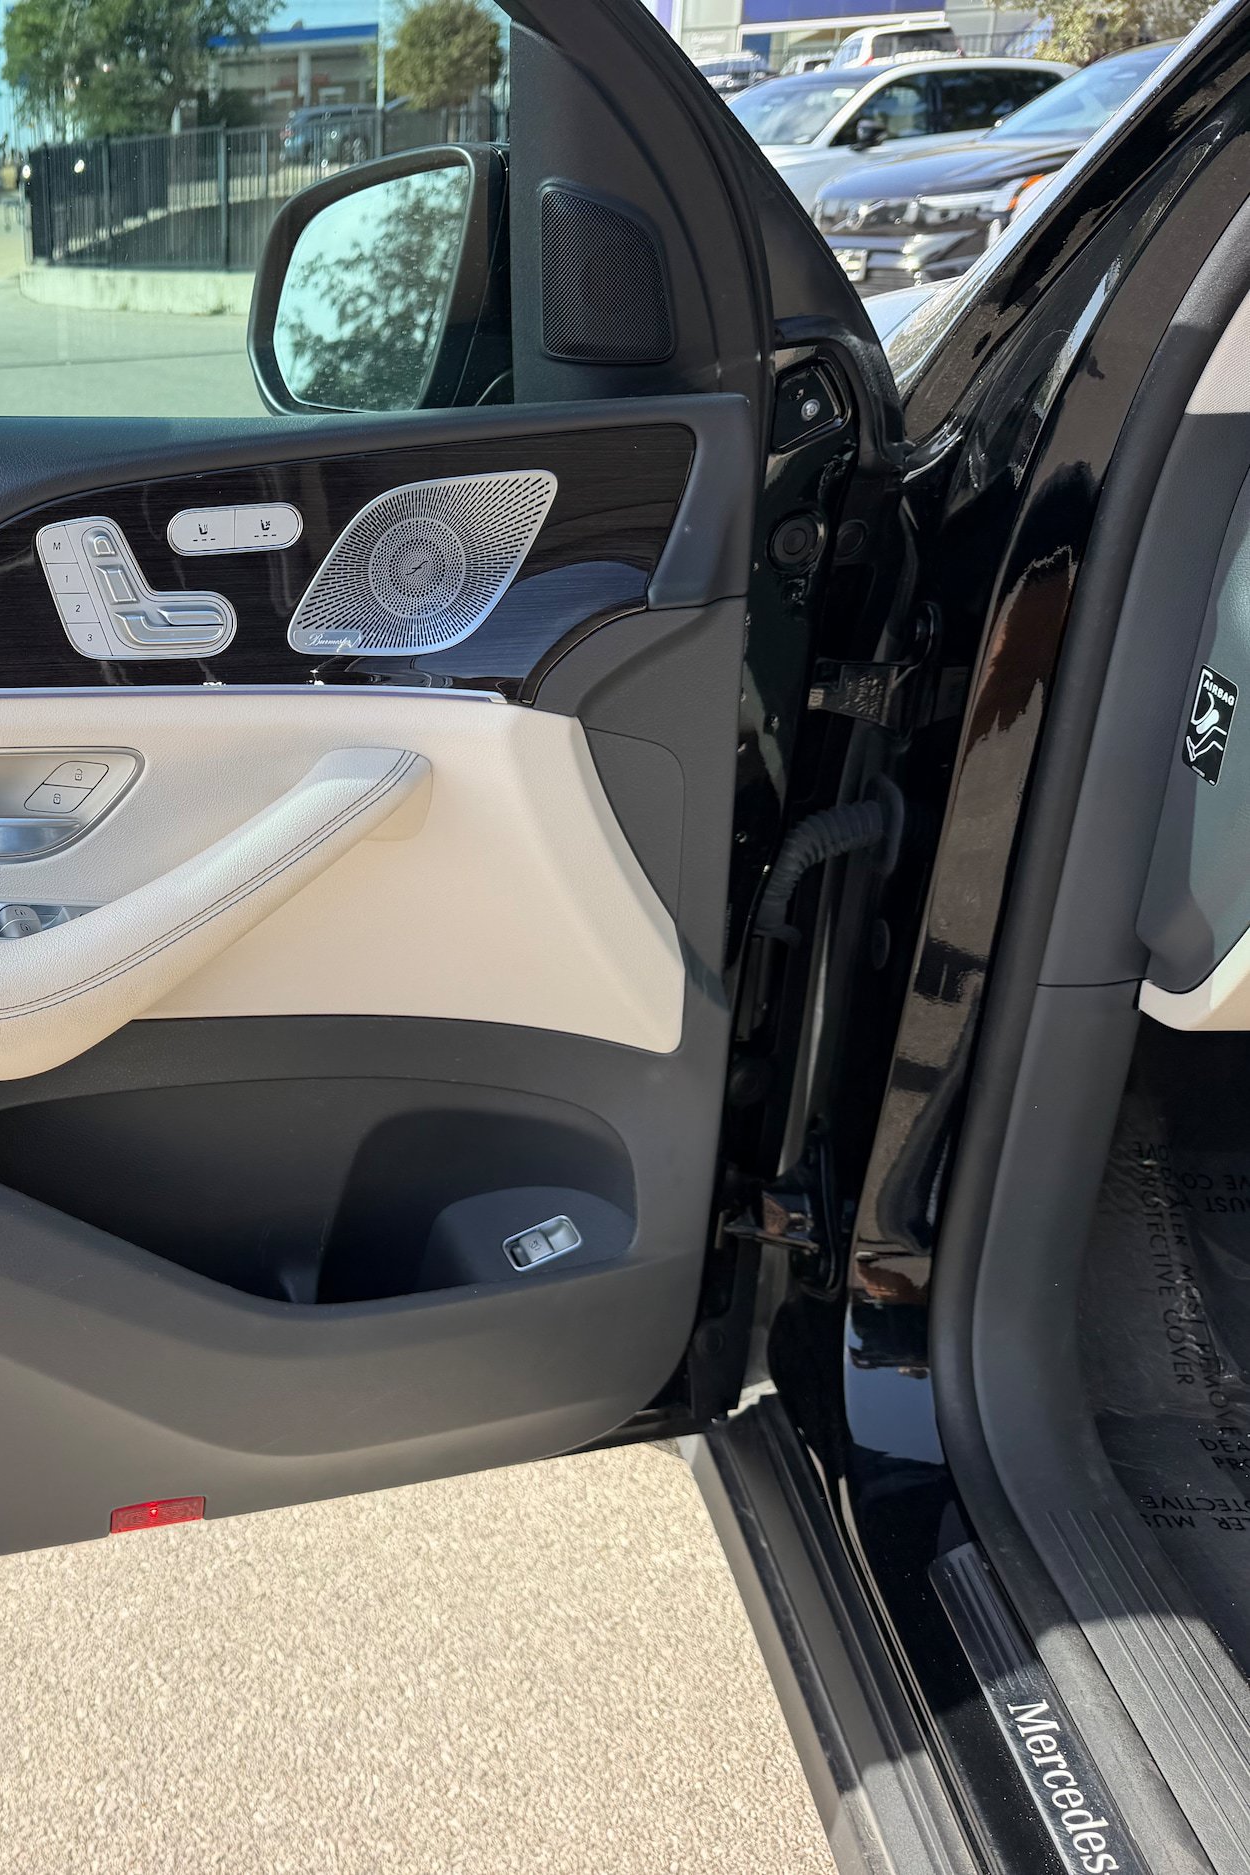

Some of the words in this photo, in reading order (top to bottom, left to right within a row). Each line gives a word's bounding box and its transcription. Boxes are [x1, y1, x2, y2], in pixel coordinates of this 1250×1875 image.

[53, 542, 61, 550] M
[75, 604, 81, 613] 2
[87, 633, 93, 642] 3
[1203, 679, 1235, 706] AIRBAG
[1205, 1197, 1250, 1212] UST
[1163, 1309, 1195, 1384] COVER
[1007, 1699, 1119, 1874] Mercedes
